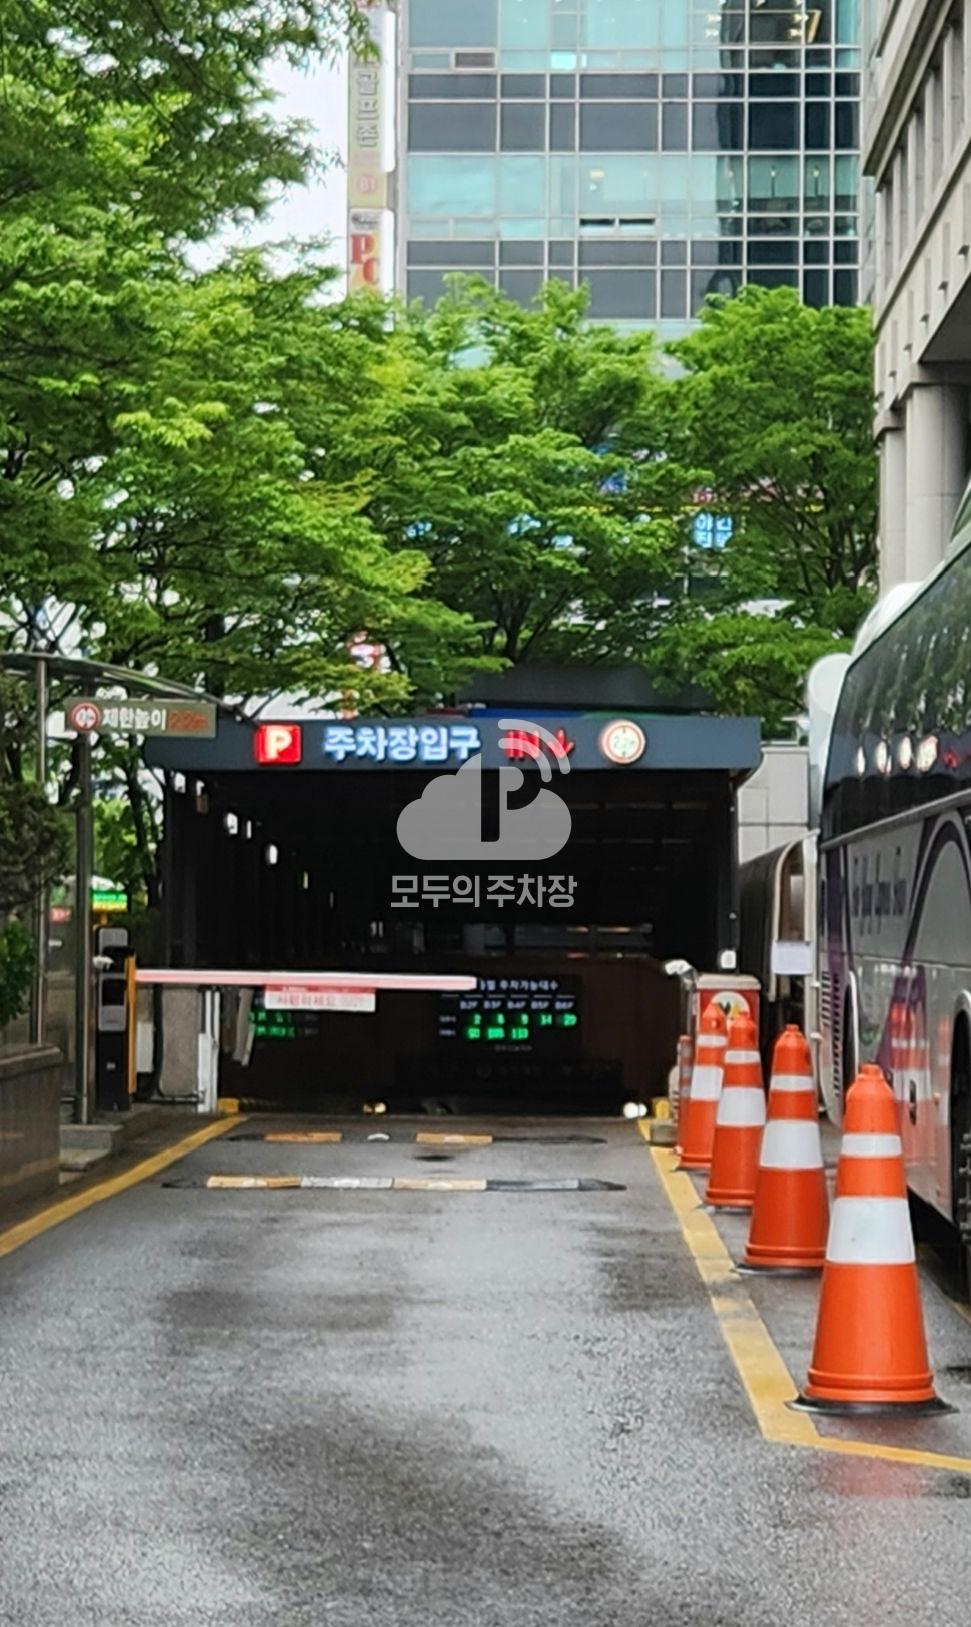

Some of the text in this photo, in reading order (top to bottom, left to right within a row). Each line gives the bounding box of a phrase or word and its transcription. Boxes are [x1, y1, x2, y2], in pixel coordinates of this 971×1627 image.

[102, 707, 167, 731] 제한높이
[265, 729, 293, 759] P
[325, 726, 481, 761] 주차장입구
